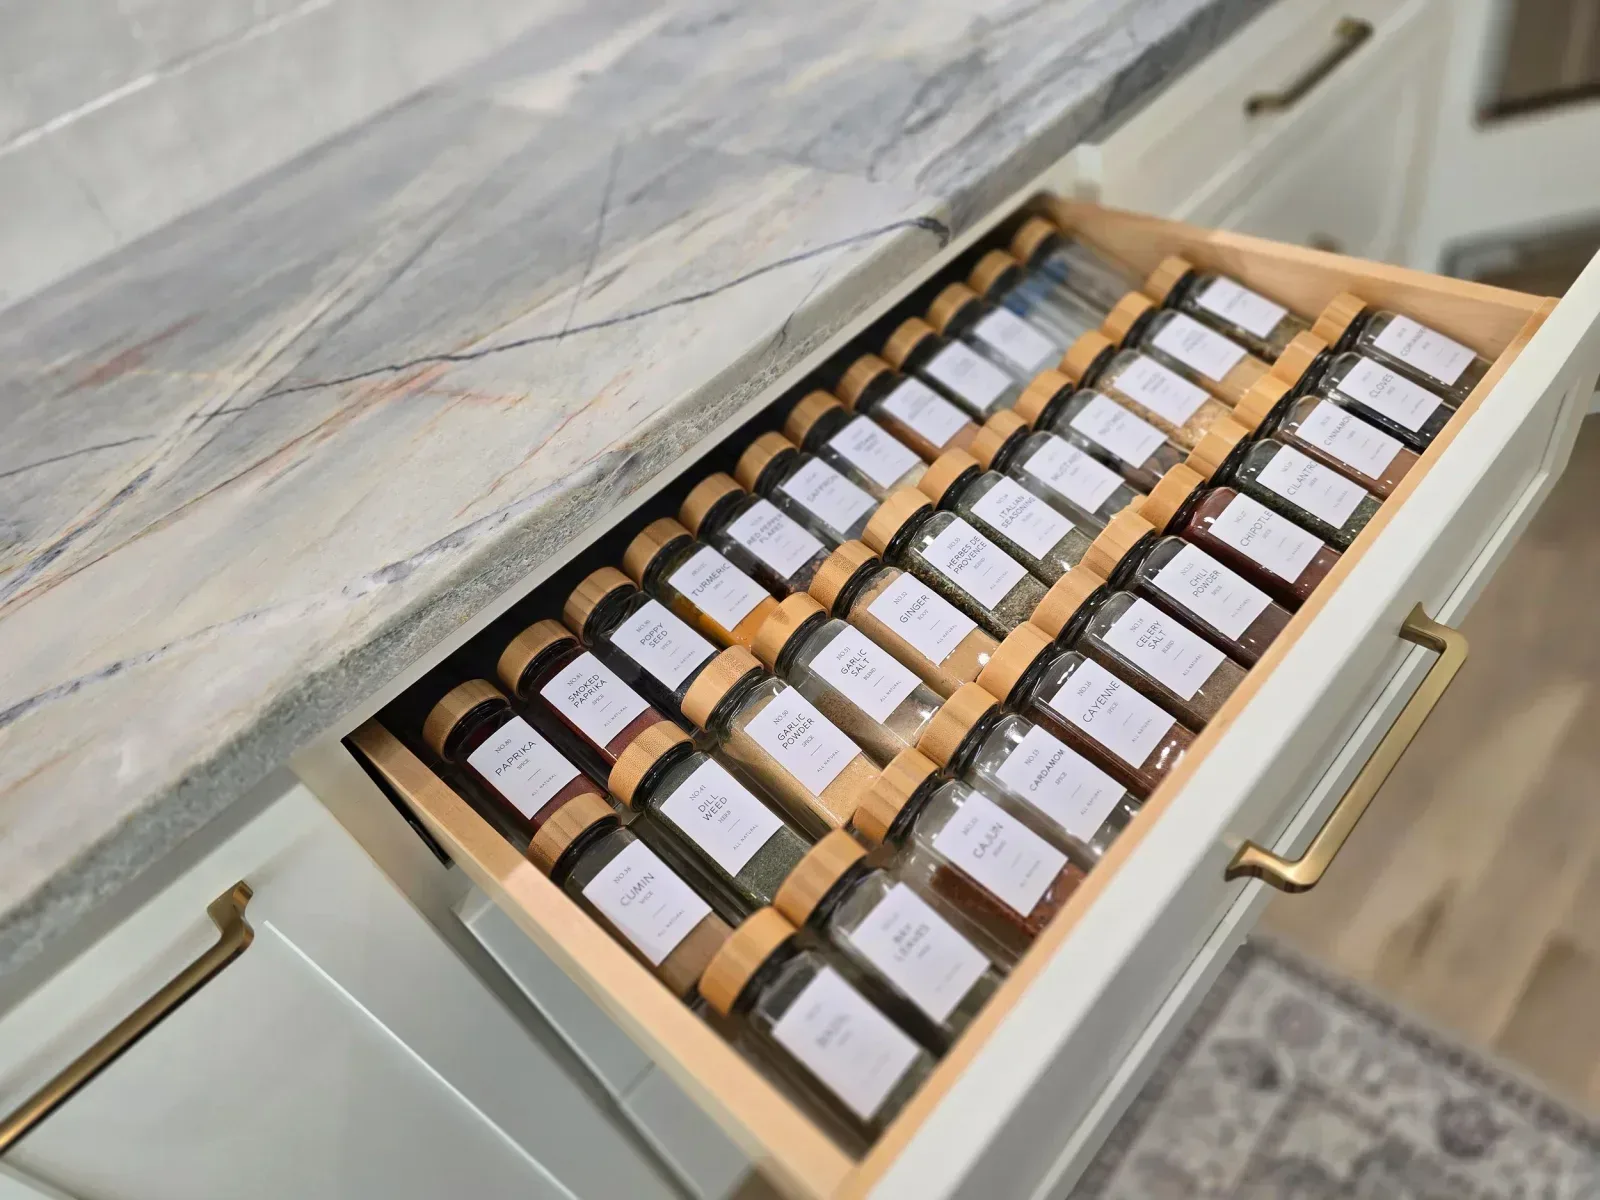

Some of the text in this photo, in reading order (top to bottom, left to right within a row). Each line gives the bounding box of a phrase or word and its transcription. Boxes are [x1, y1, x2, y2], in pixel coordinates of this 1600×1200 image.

[1369, 373, 1394, 399] CLOVES
[999, 495, 1025, 518] ITALIAN
[1001, 497, 1035, 528] SEASONING
[1240, 510, 1273, 547] CHIPOTLE
[947, 535, 981, 569] HERBES DE
[954, 542, 987, 574] PROVENCE
[692, 563, 731, 596] TURMERIC
[1190, 569, 1208, 586] CHILI
[1192, 570, 1221, 598] POWDER
[900, 594, 930, 623] GINGER
[640, 622, 663, 645] POPPY
[649, 630, 667, 648] SEED
[1136, 620, 1162, 648] CELERY
[1148, 630, 1167, 649] SALT
[841, 649, 867, 675] GARLIC
[851, 658, 870, 677] SALT
[568, 674, 599, 702] SMOKED
[574, 680, 607, 708] PAPRIKA
[886, 681, 901, 695] NATURAL
[1082, 680, 1120, 722] CAYENNE
[777, 713, 805, 741] GARLIC
[782, 718, 814, 750] POWDER
[802, 735, 814, 747] SPICE
[495, 741, 536, 776] PAPRIKA
[824, 750, 839, 765] NATURAL
[1030, 748, 1065, 791] CARDAMOM
[698, 794, 719, 812] DILL
[702, 796, 727, 821] WEED
[718, 810, 731, 824] HERB
[733, 824, 758, 851] ALL NATURAL
[973, 823, 1004, 859] CAJUN
[620, 872, 654, 906] CUMIN
